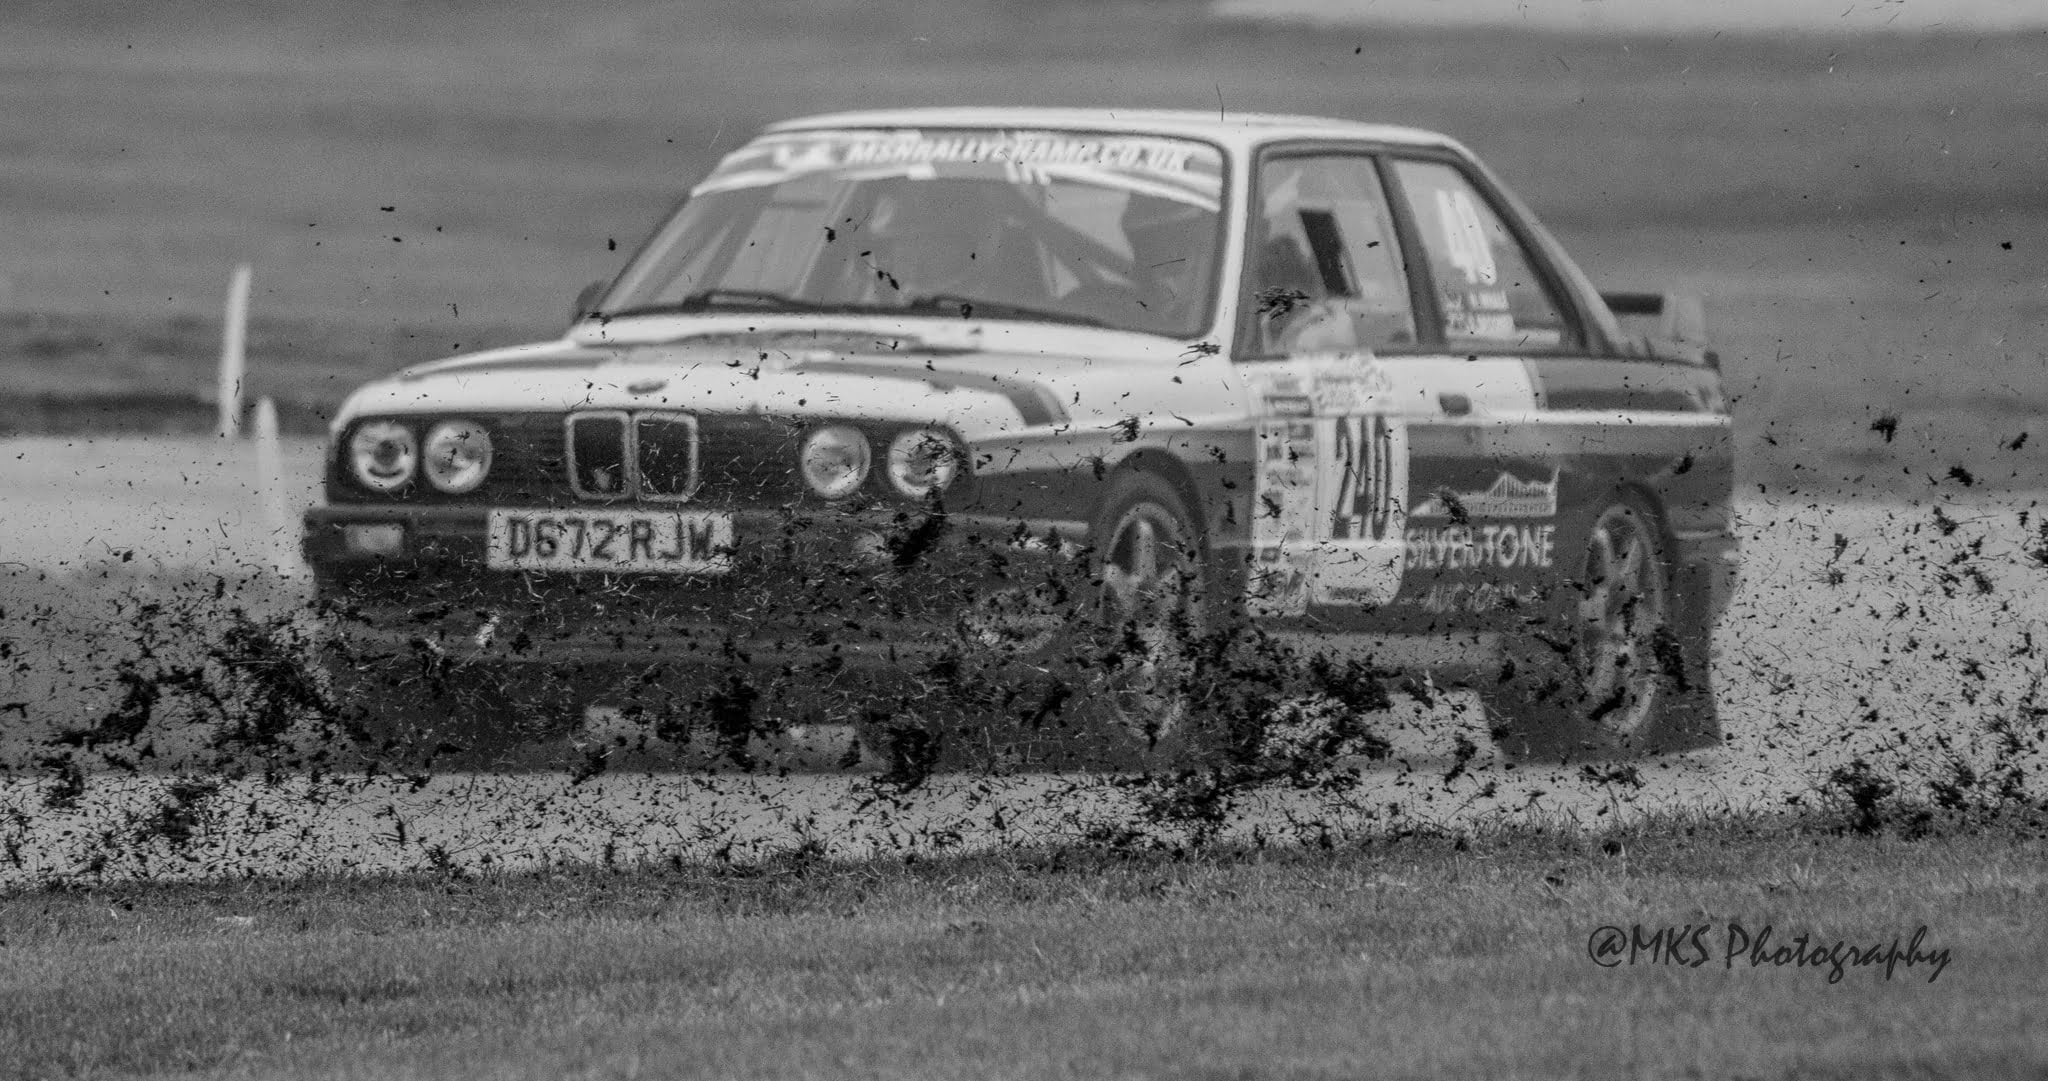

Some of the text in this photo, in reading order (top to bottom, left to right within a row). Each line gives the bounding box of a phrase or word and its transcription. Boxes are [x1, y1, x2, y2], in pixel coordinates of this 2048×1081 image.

[1333, 415, 1391, 541] 240
[508, 517, 714, 561] D672 RJW
